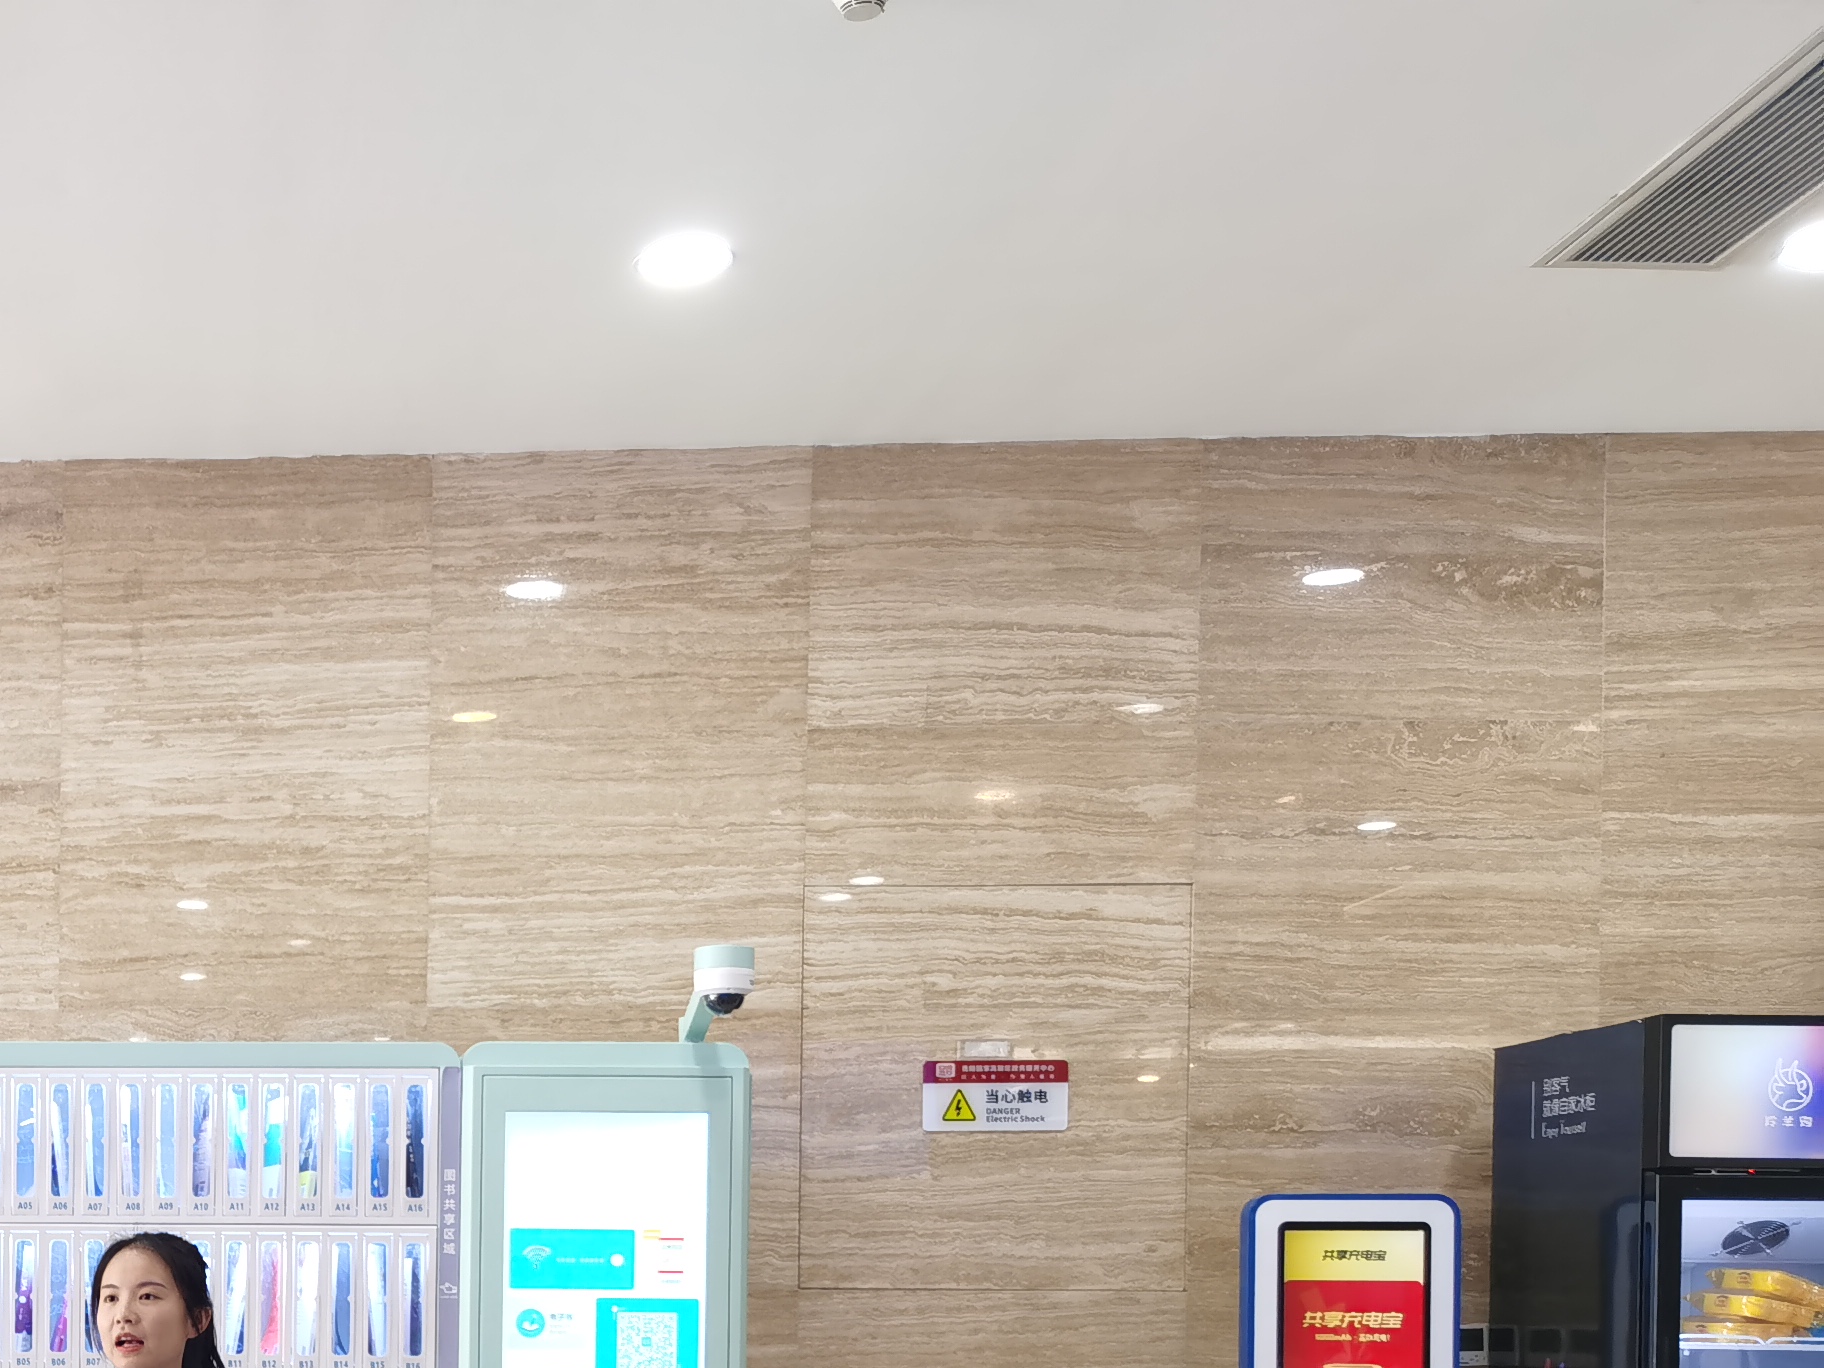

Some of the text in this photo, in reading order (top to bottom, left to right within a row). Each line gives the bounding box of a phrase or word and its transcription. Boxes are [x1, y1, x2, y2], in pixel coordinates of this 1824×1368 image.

[985, 1089, 1048, 1104] 当心触电
[986, 1107, 1021, 1115] DANGER
[986, 1115, 1046, 1123] Electric Shock
[17, 1202, 33, 1210] A05
[52, 1202, 68, 1210] A06
[87, 1203, 103, 1211] A07
[125, 1202, 141, 1211] A08
[158, 1202, 174, 1211] A09
[193, 1203, 209, 1211] A10
[229, 1203, 244, 1211] A11
[263, 1202, 280, 1211] A12
[299, 1203, 316, 1211] A13
[334, 1203, 351, 1212] A14
[372, 1203, 388, 1212] A15
[407, 1204, 424, 1213] A16
[443, 1169, 456, 1255] 图书共享区域
[1322, 1250, 1387, 1261] 共享充电宝
[1302, 1311, 1403, 1328] 共享充电宝
[16, 1358, 31, 1366] B05
[51, 1358, 66, 1366] B06
[86, 1358, 101, 1366] B07
[227, 1359, 243, 1368] B11
[261, 1359, 277, 1368] B12
[298, 1360, 314, 1368] B13
[333, 1360, 349, 1368] B14
